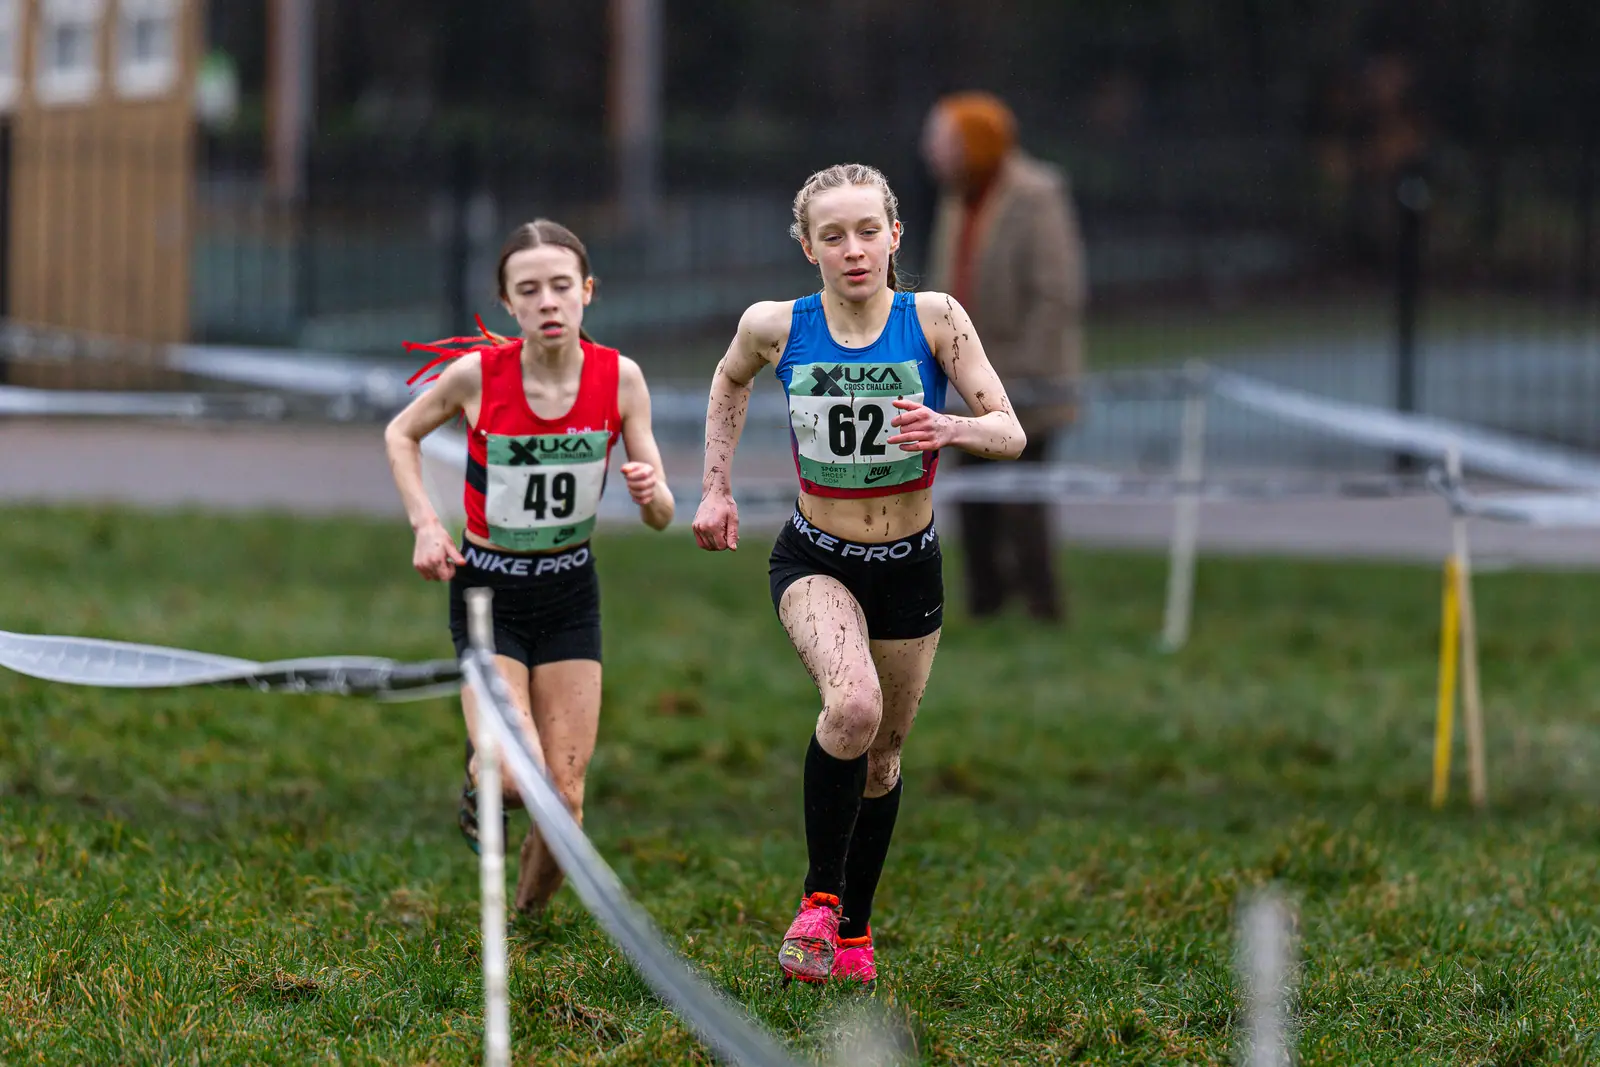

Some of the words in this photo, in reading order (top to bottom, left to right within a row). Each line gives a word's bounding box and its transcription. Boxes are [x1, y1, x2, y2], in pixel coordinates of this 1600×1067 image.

[844, 367, 902, 383] UKA
[844, 383, 865, 391] CROSS
[866, 382, 903, 391] CHALLENGE
[828, 404, 886, 456] 62
[540, 438, 593, 453] UKA
[523, 472, 577, 520] 49
[465, 547, 533, 576] NIKE
[535, 548, 589, 576] PRO
[841, 541, 912, 562] PRO
